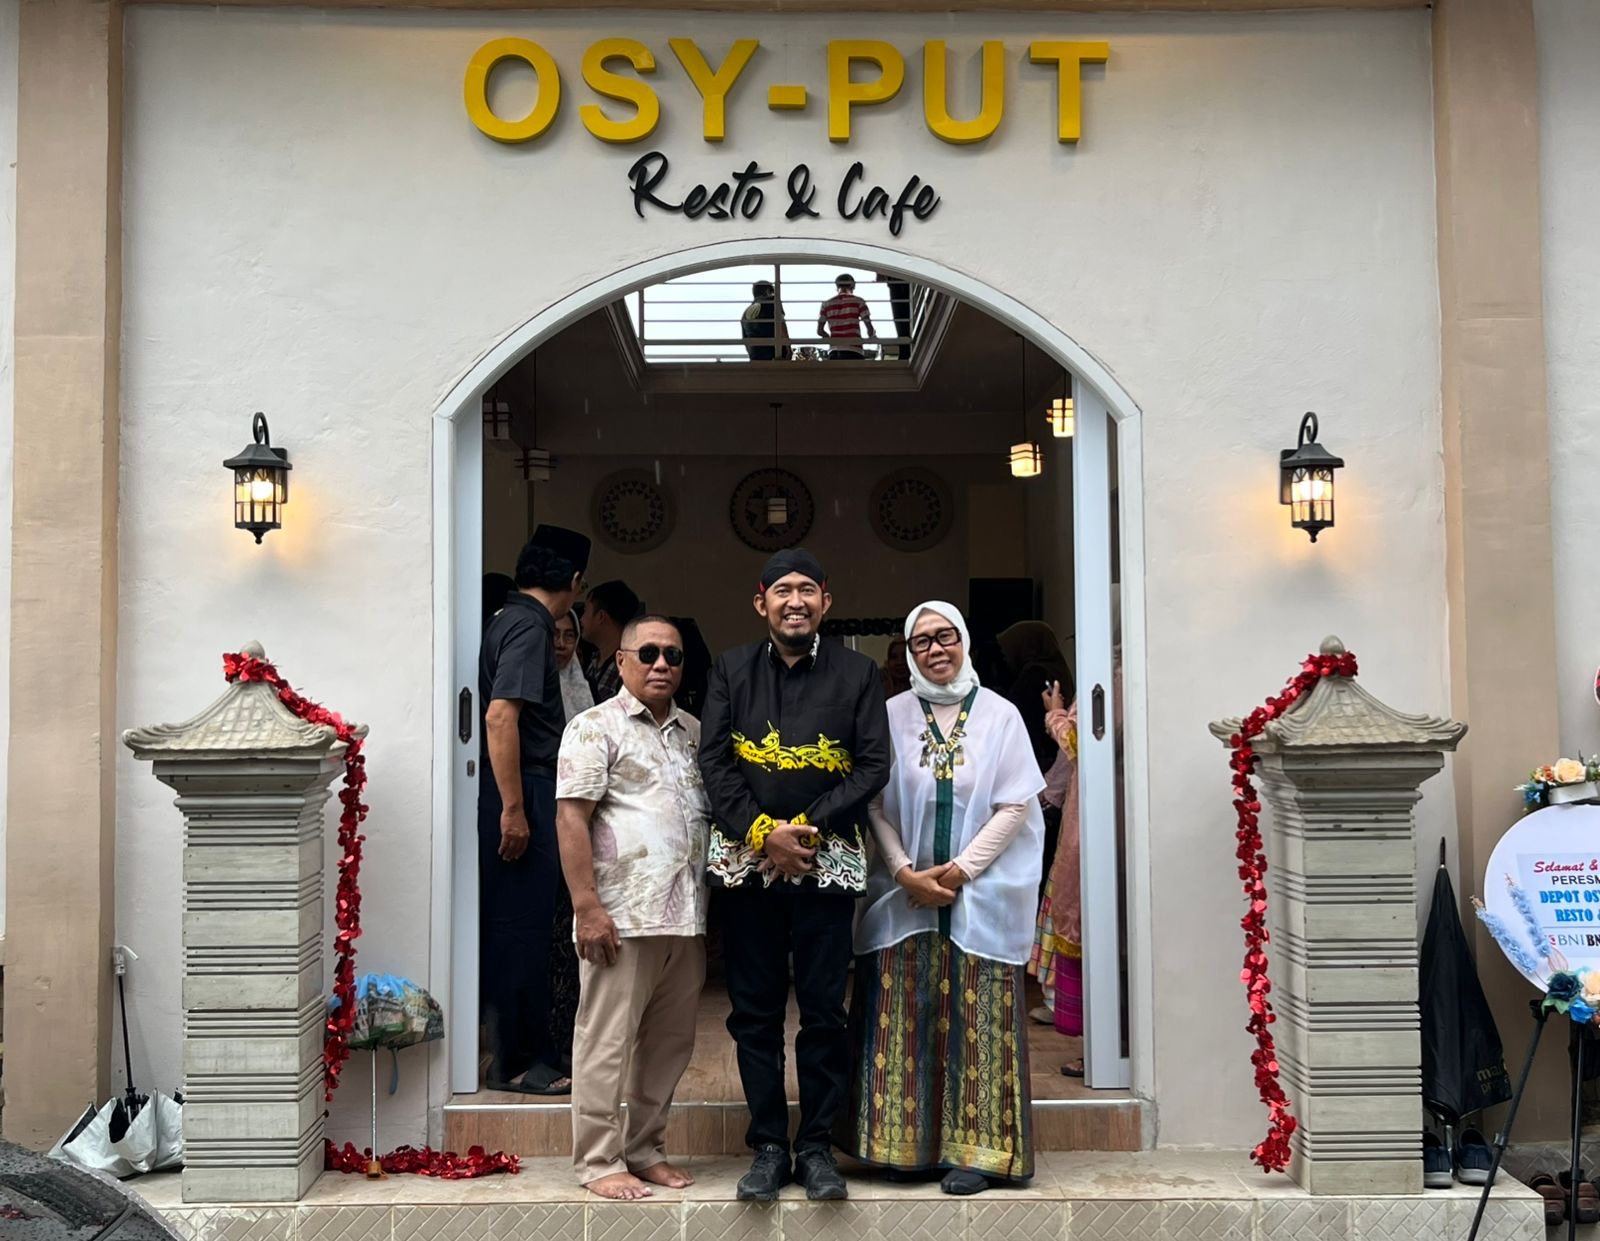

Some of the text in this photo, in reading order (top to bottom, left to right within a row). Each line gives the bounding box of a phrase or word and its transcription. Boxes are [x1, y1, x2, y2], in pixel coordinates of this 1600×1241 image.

[463, 37, 1109, 144] OSY-PUT
[627, 151, 941, 236] Resto & Cafe
[1533, 859, 1598, 873] Selamat &
[1539, 890, 1580, 903] DEPOT
[1555, 909, 1593, 922] RESTO
[1557, 934, 1585, 946] BNI
